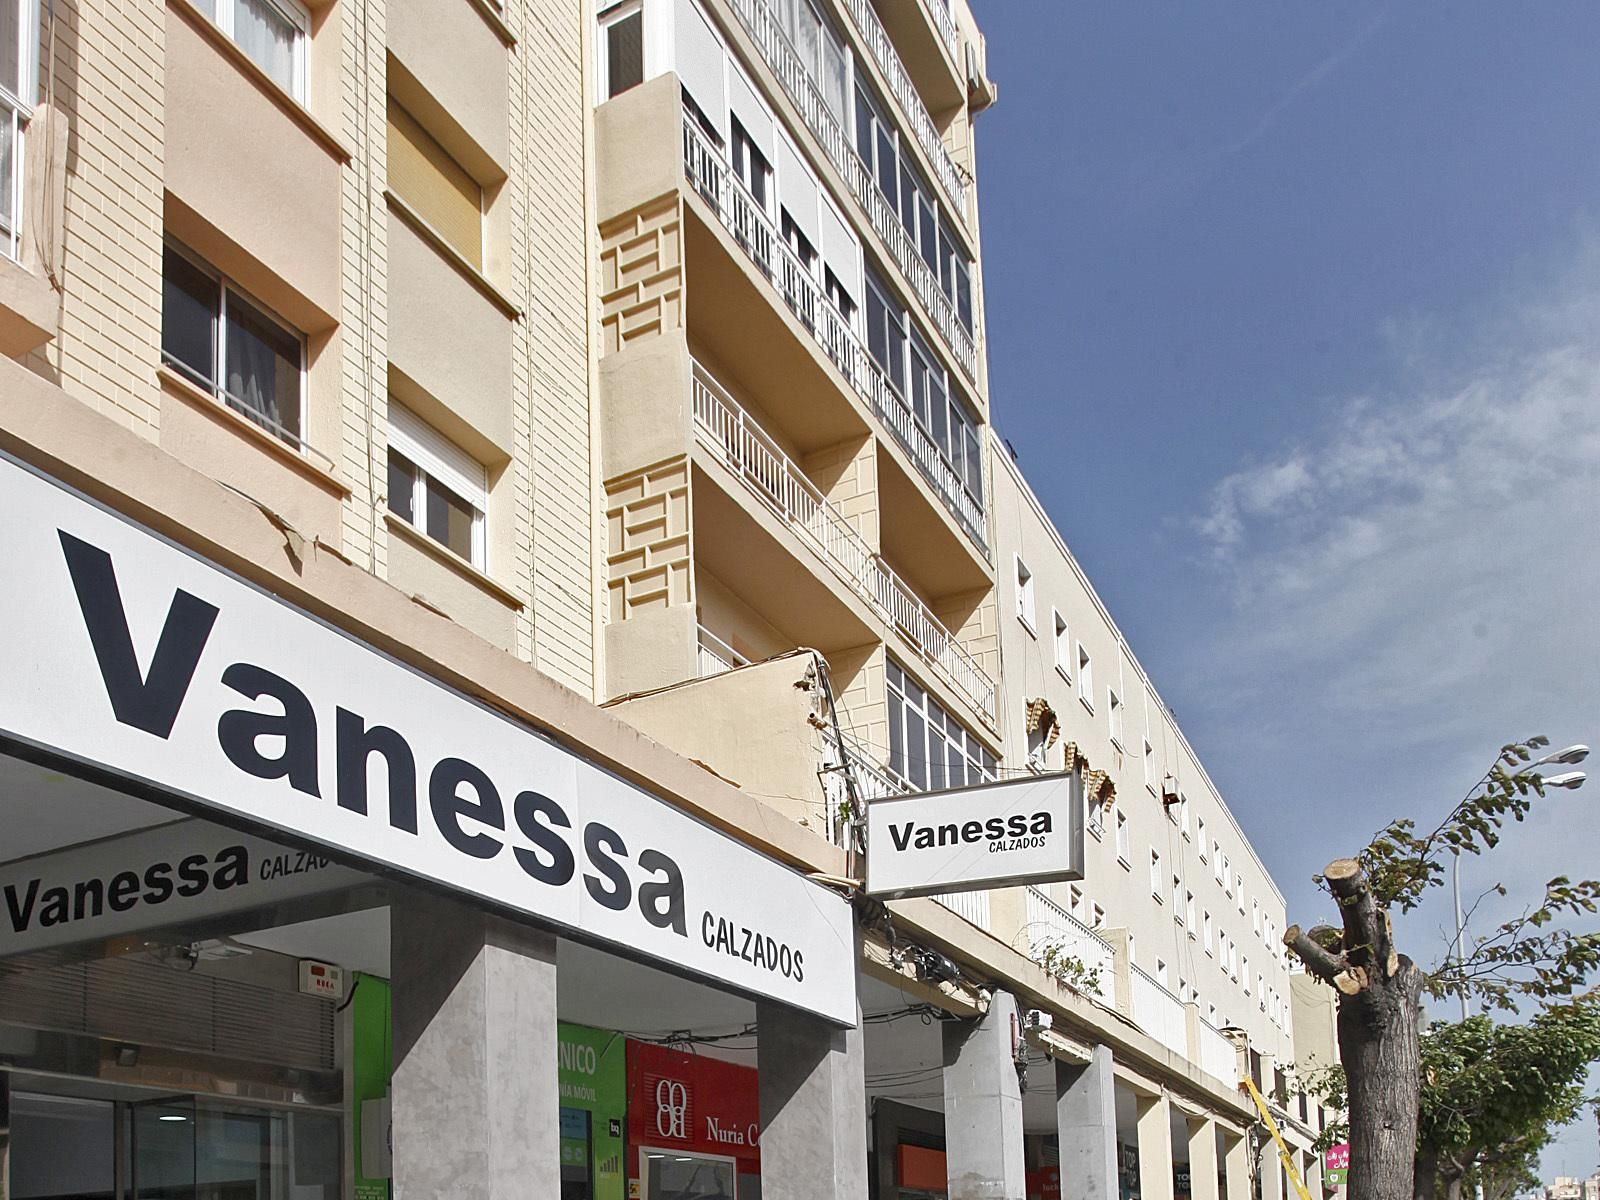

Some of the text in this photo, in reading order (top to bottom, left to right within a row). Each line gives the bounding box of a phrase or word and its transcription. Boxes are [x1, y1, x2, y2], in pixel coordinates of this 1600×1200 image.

[57, 528, 804, 983] Vanessa CALZADOS
[888, 811, 1053, 852] Vanessa
[989, 836, 1046, 853] CALZADOS
[4, 845, 332, 933] Vanessa CALZAD
[559, 1040, 596, 1075] NICO
[706, 1116, 744, 1145] Nuria
[1177, 1174, 1190, 1182] TO
[1177, 1182, 1190, 1190] TO
